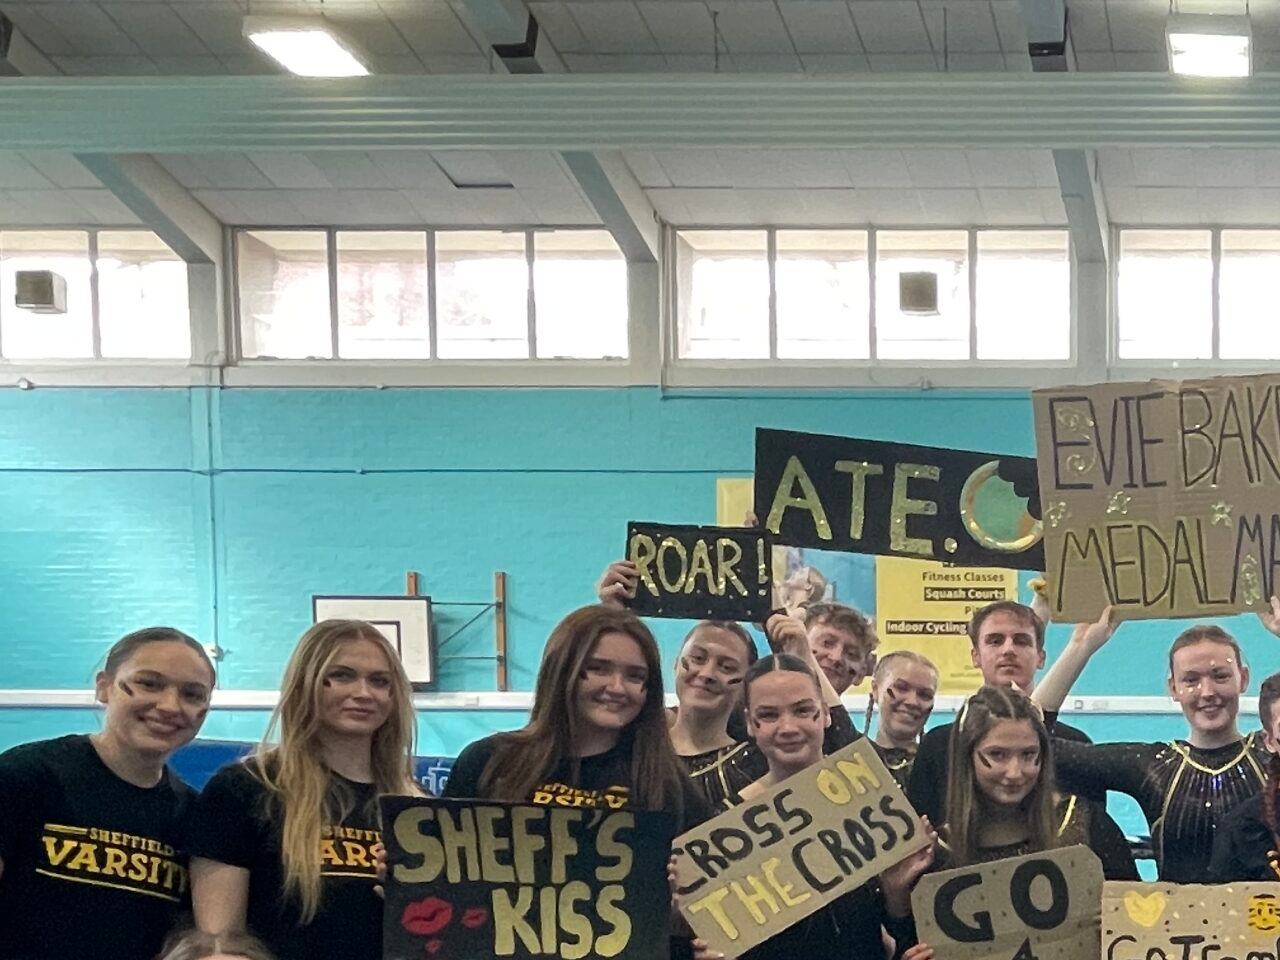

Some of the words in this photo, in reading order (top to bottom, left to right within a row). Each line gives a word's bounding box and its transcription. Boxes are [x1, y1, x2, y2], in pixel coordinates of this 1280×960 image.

[1048, 392, 1168, 491] EVIE
[765, 455, 959, 556] ATE.
[922, 571, 961, 583] Fitness
[964, 571, 1005, 583] Classes
[924, 587, 966, 601] Squash
[967, 588, 1006, 600] Courts
[1055, 518, 1230, 613] MEDAL
[886, 621, 924, 633] Indoor
[925, 621, 967, 635] Cycling
[815, 751, 882, 805] ON
[89, 827, 175, 857] SHEFFIELD
[393, 805, 635, 884] SHEFF'S
[687, 856, 812, 941] THE
[791, 795, 916, 894] CROSS
[491, 884, 633, 960] KISS
[933, 858, 1070, 944] GO
